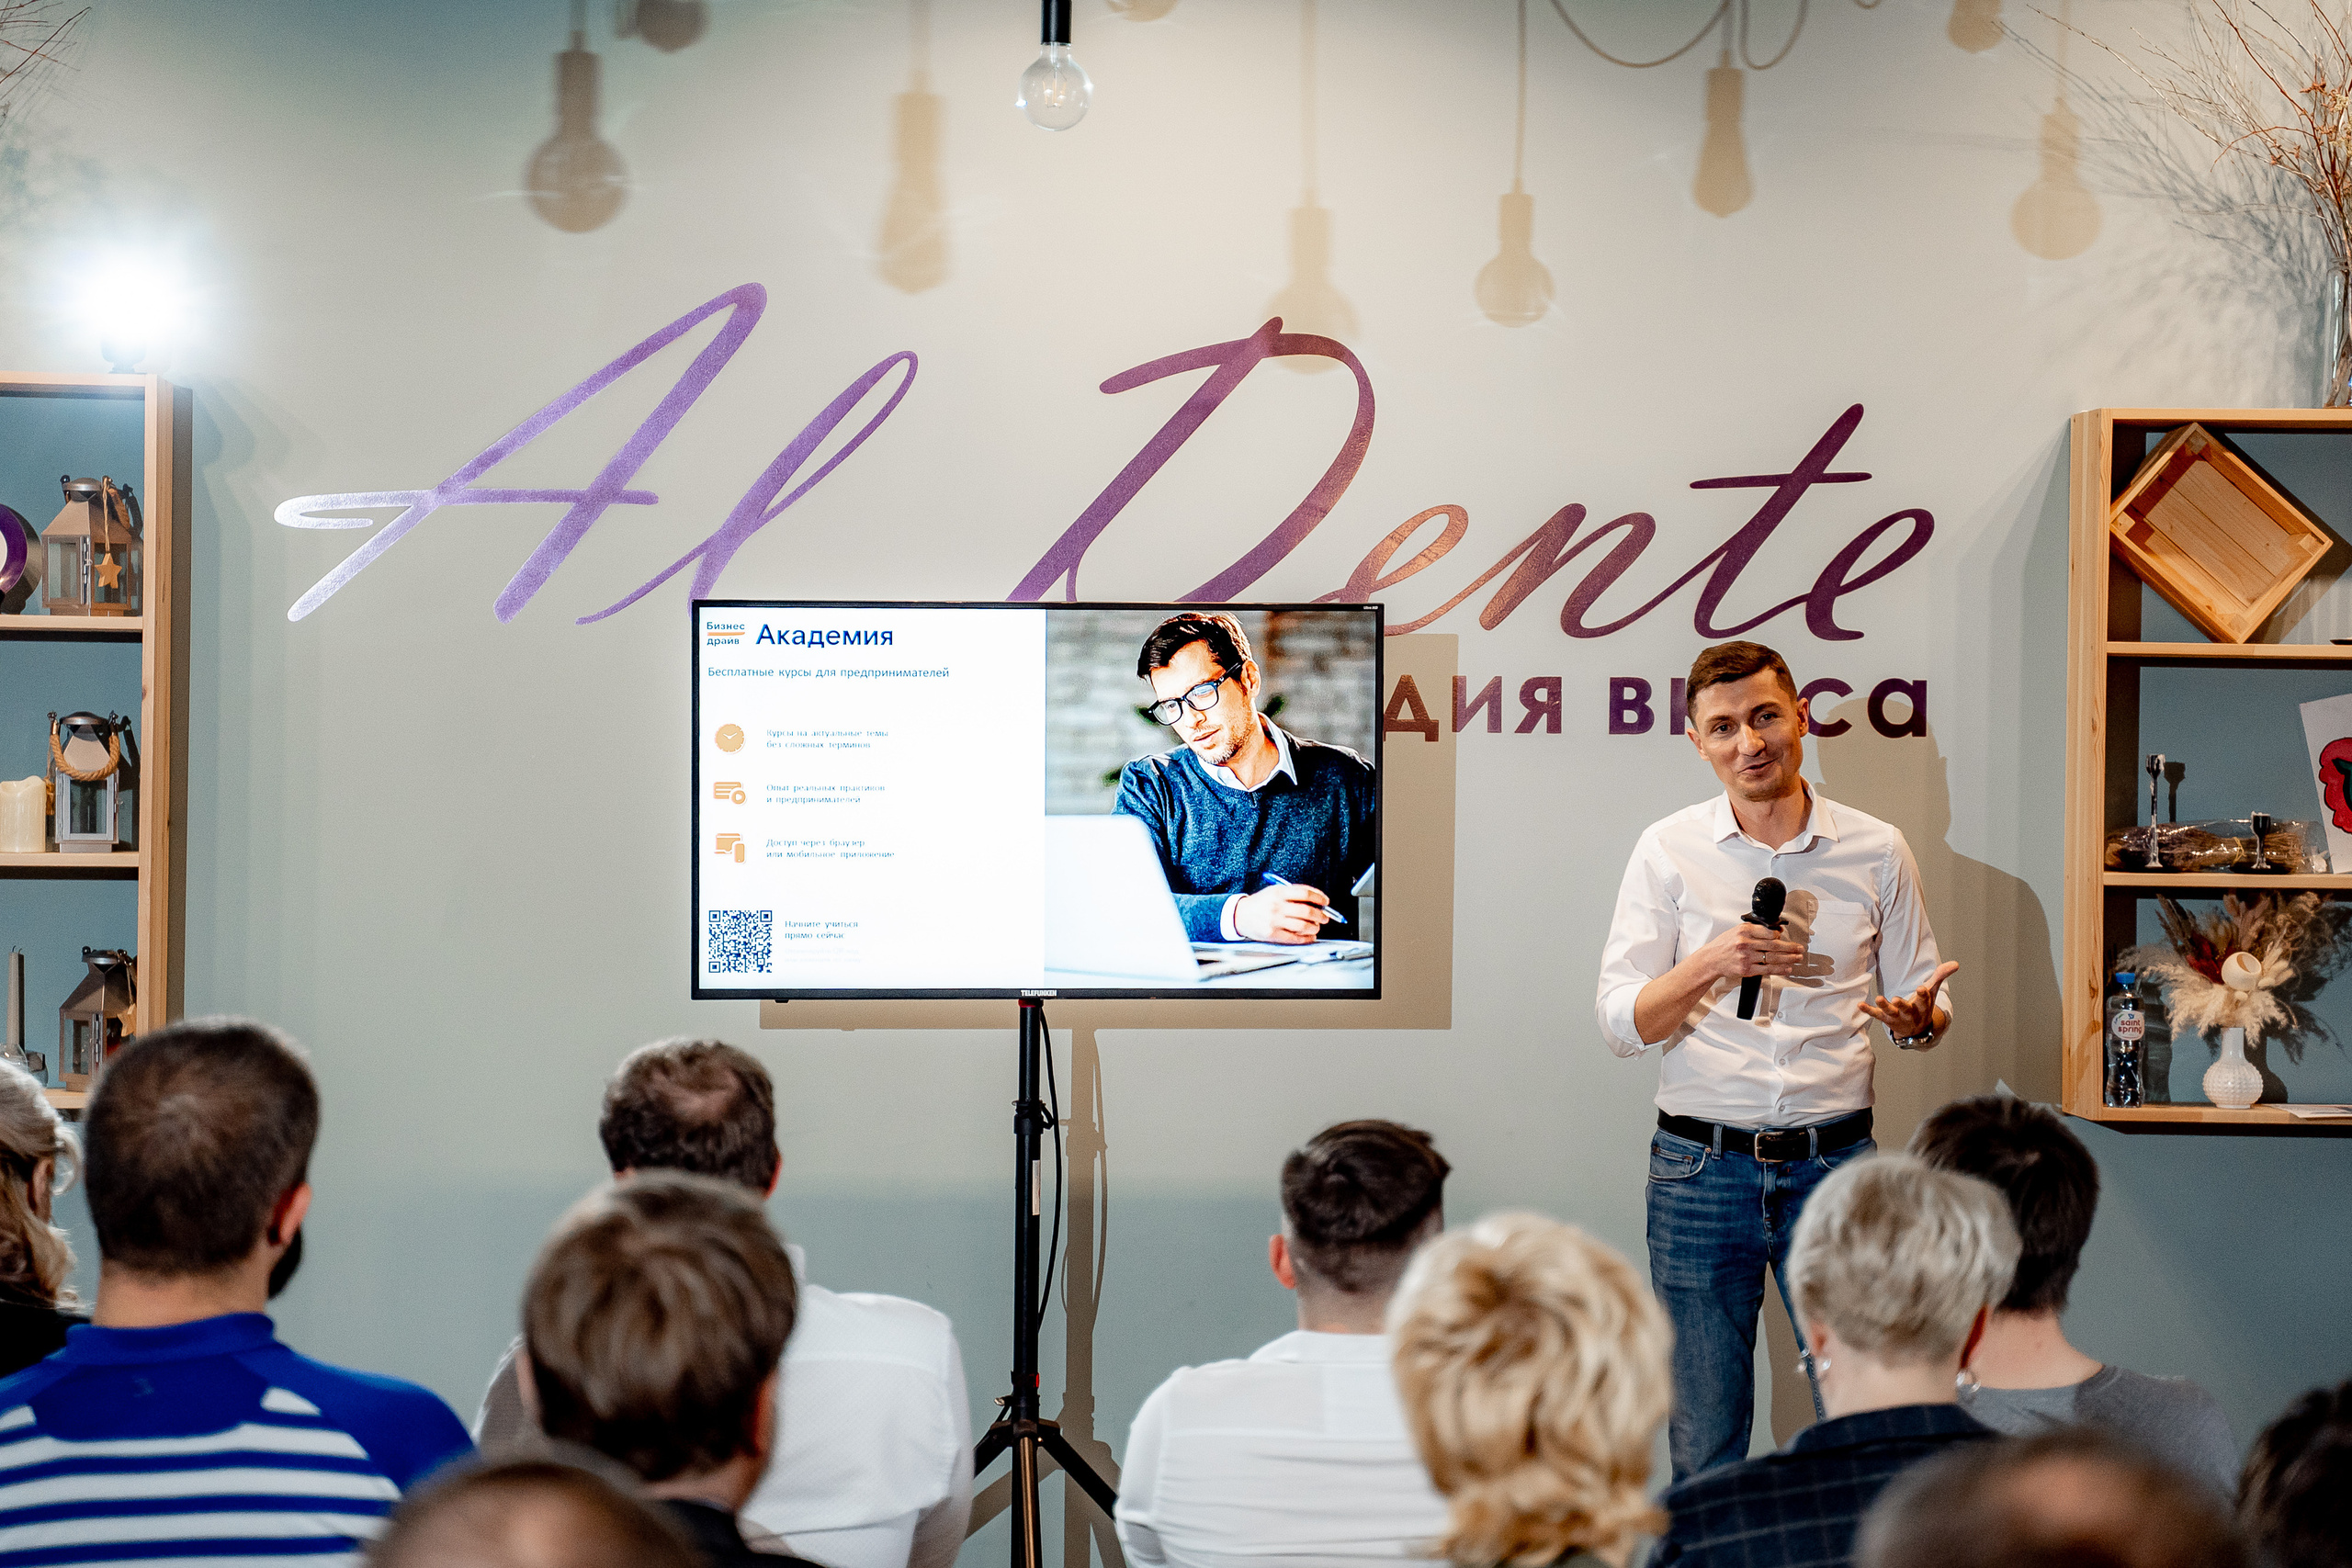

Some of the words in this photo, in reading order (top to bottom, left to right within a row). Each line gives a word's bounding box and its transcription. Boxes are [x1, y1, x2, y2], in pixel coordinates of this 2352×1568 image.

[274, 282, 918, 625] Al
[1005, 317, 1934, 640] Dente
[706, 621, 746, 631] Бизнес
[706, 637, 740, 648] драйв
[755, 624, 893, 649] Академия
[707, 666, 775, 677] Бесплатные
[778, 669, 812, 680] курсы
[815, 669, 836, 679] для
[840, 666, 950, 680] предпринимателей
[1384, 675, 1562, 742] дия
[1609, 677, 1927, 739] вса
[2118, 1026, 2143, 1034] spring
